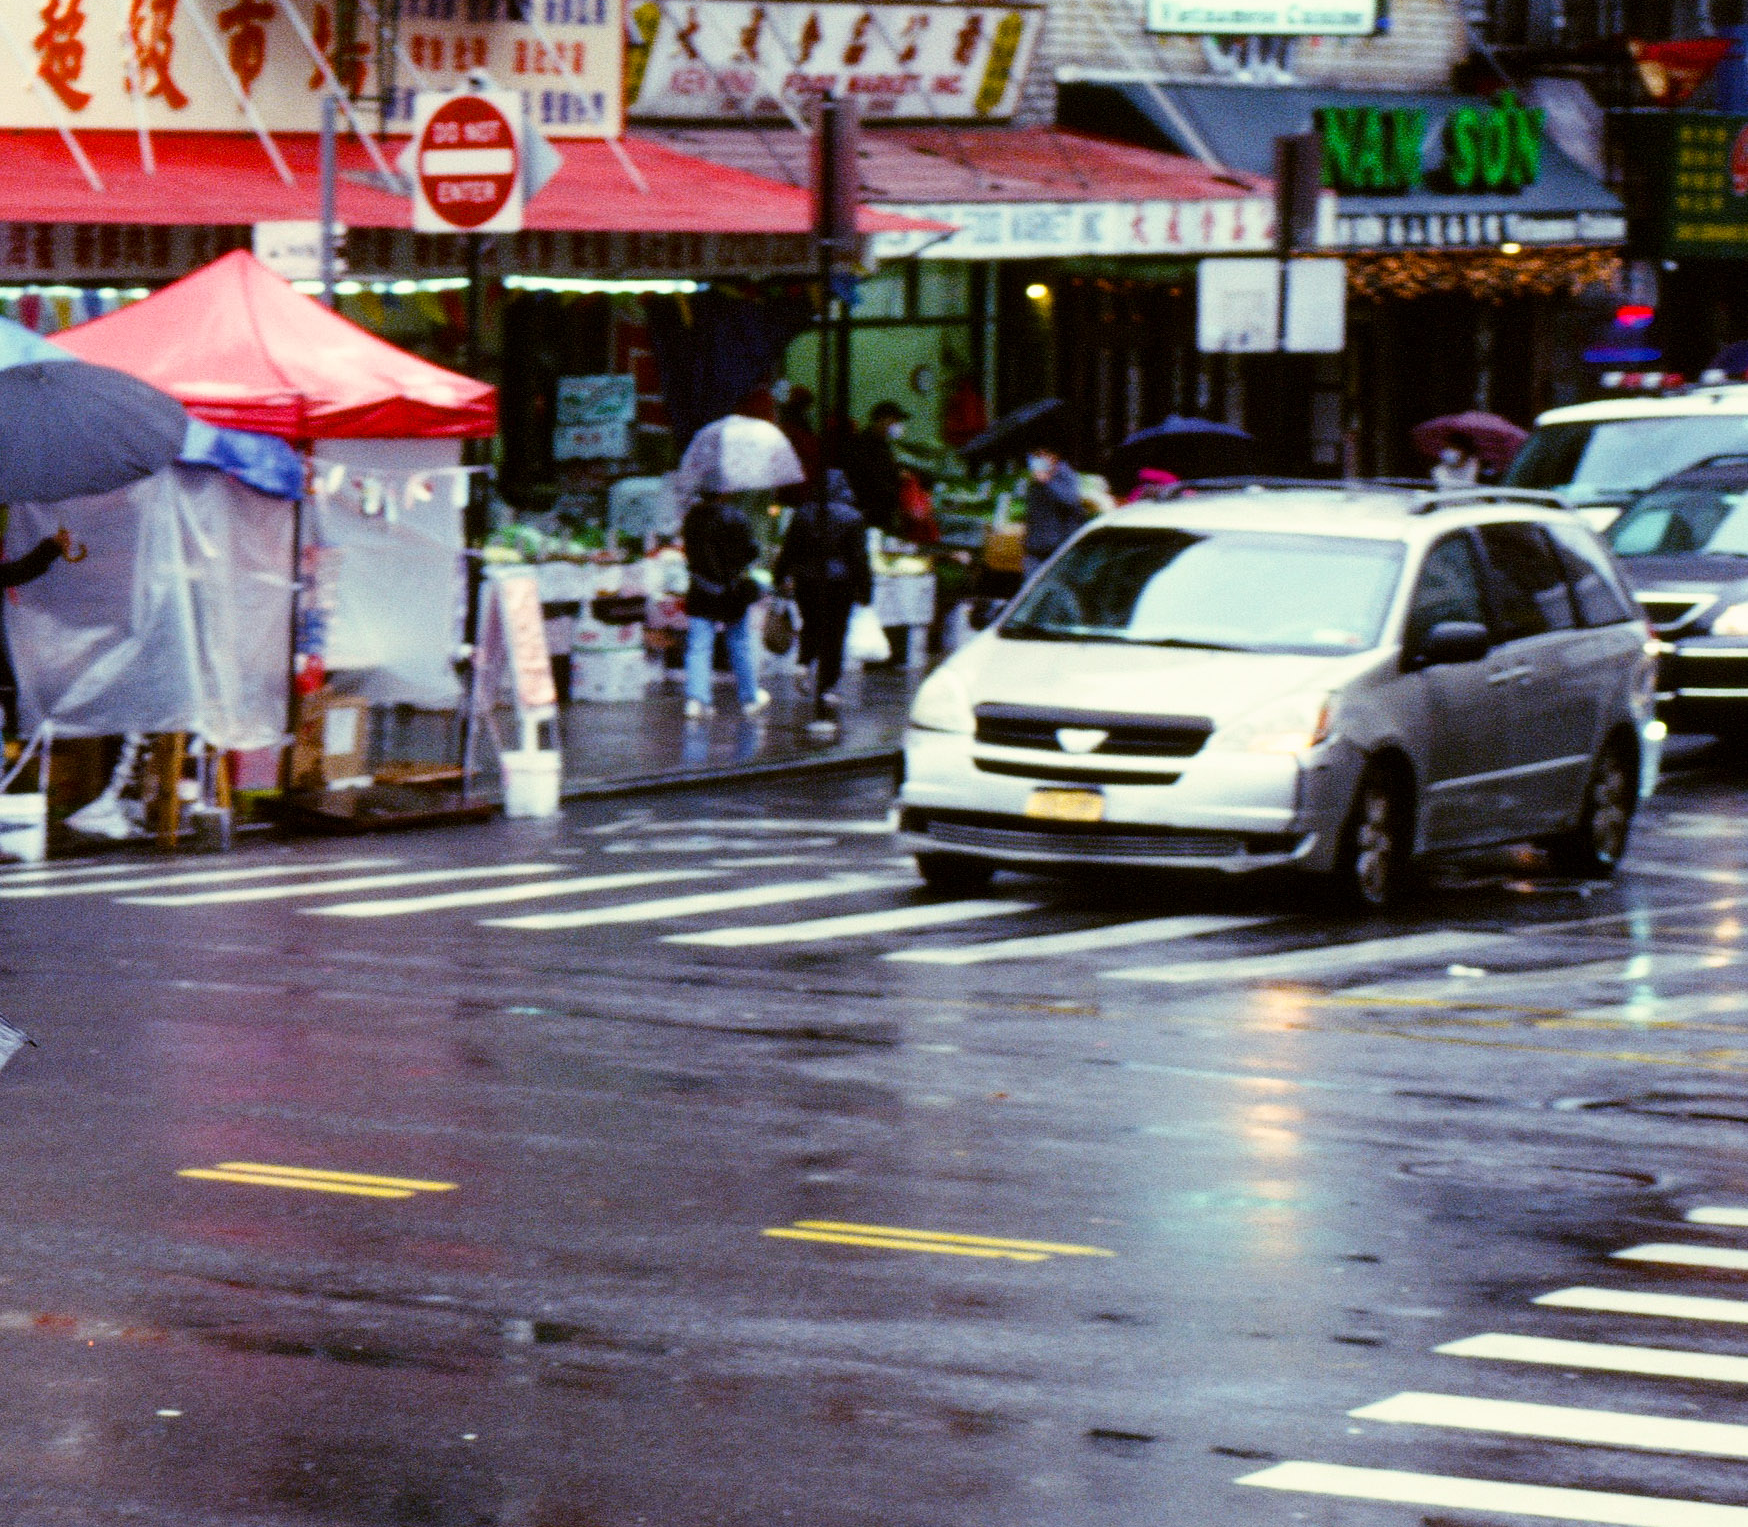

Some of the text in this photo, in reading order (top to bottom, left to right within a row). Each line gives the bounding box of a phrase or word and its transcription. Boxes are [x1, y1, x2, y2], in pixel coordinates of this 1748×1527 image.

[431, 120, 500, 145] DO NOT
[1319, 106, 1426, 187] NAM
[436, 180, 496, 204] ENTER
